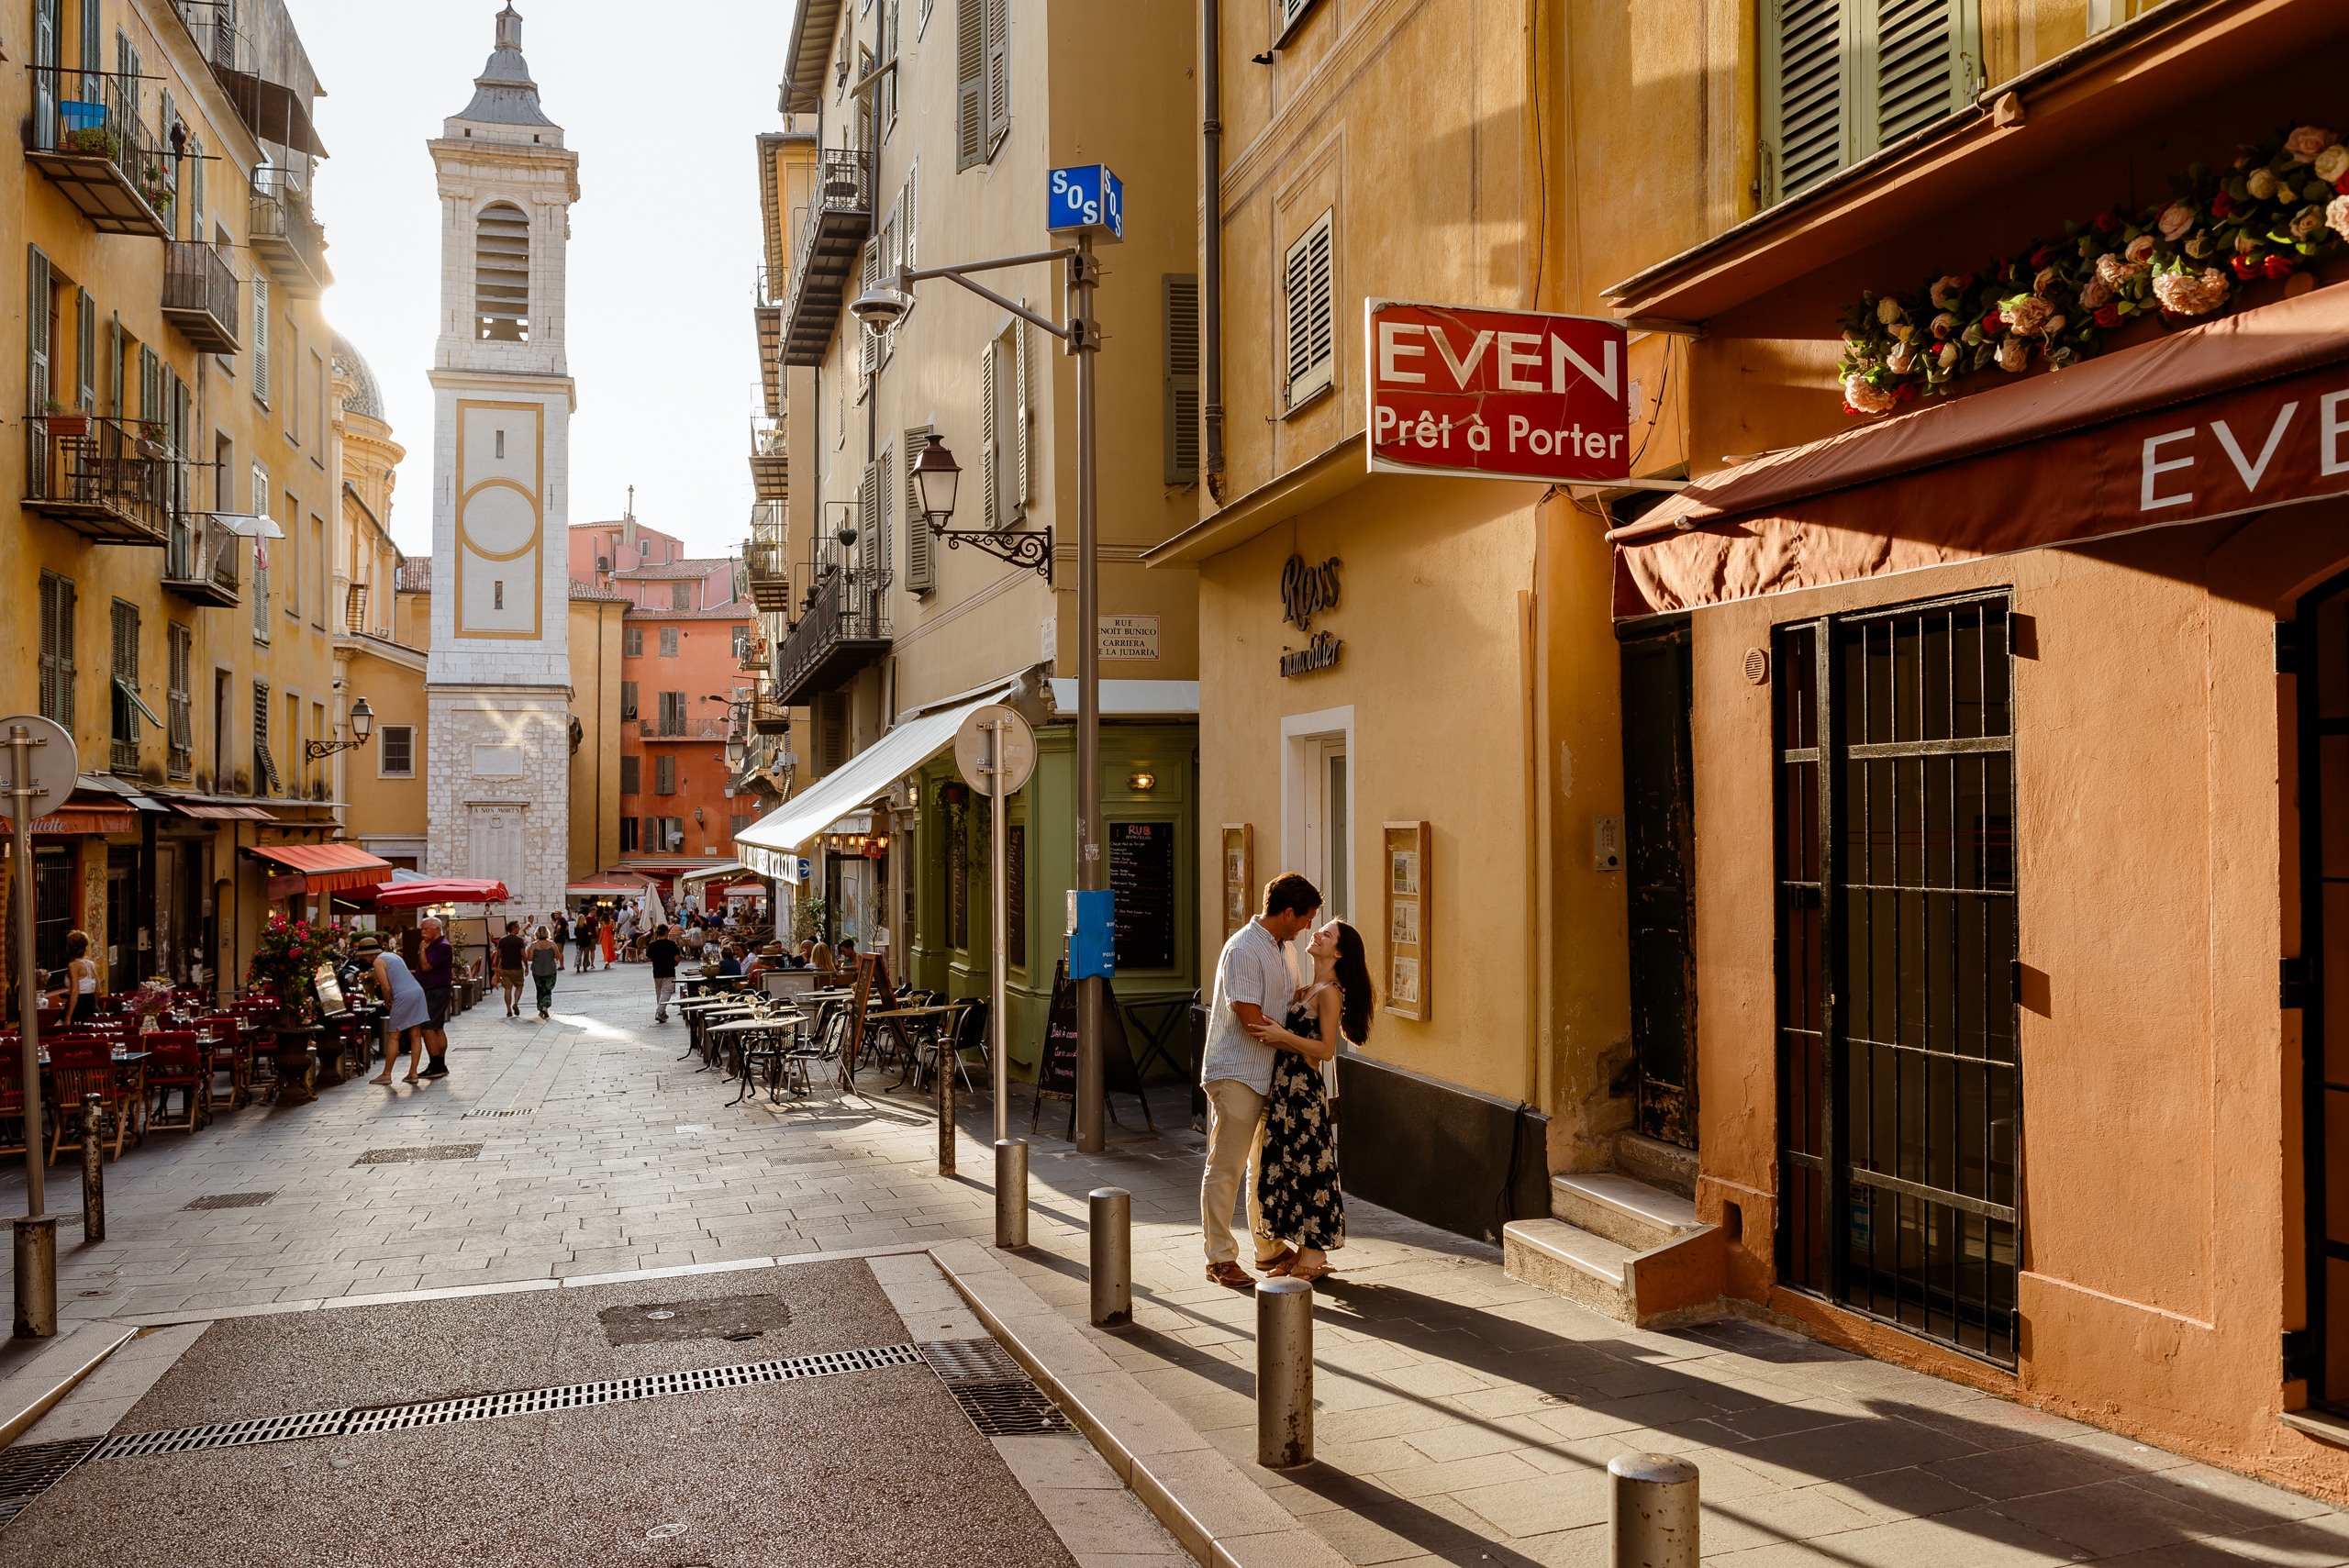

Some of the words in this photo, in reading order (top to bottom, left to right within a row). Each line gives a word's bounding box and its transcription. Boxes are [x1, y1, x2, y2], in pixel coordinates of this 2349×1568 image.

[1052, 170, 1098, 225] SOS
[1105, 169, 1121, 238] SOS
[1378, 321, 1619, 402] EVEN
[1375, 406, 1453, 450] Prêt
[1467, 413, 1491, 451] à
[1508, 415, 1624, 459] Porter
[1280, 554, 1341, 632] Ross
[1124, 628, 1157, 636] BUNICO
[1128, 824, 1152, 836] RUB
